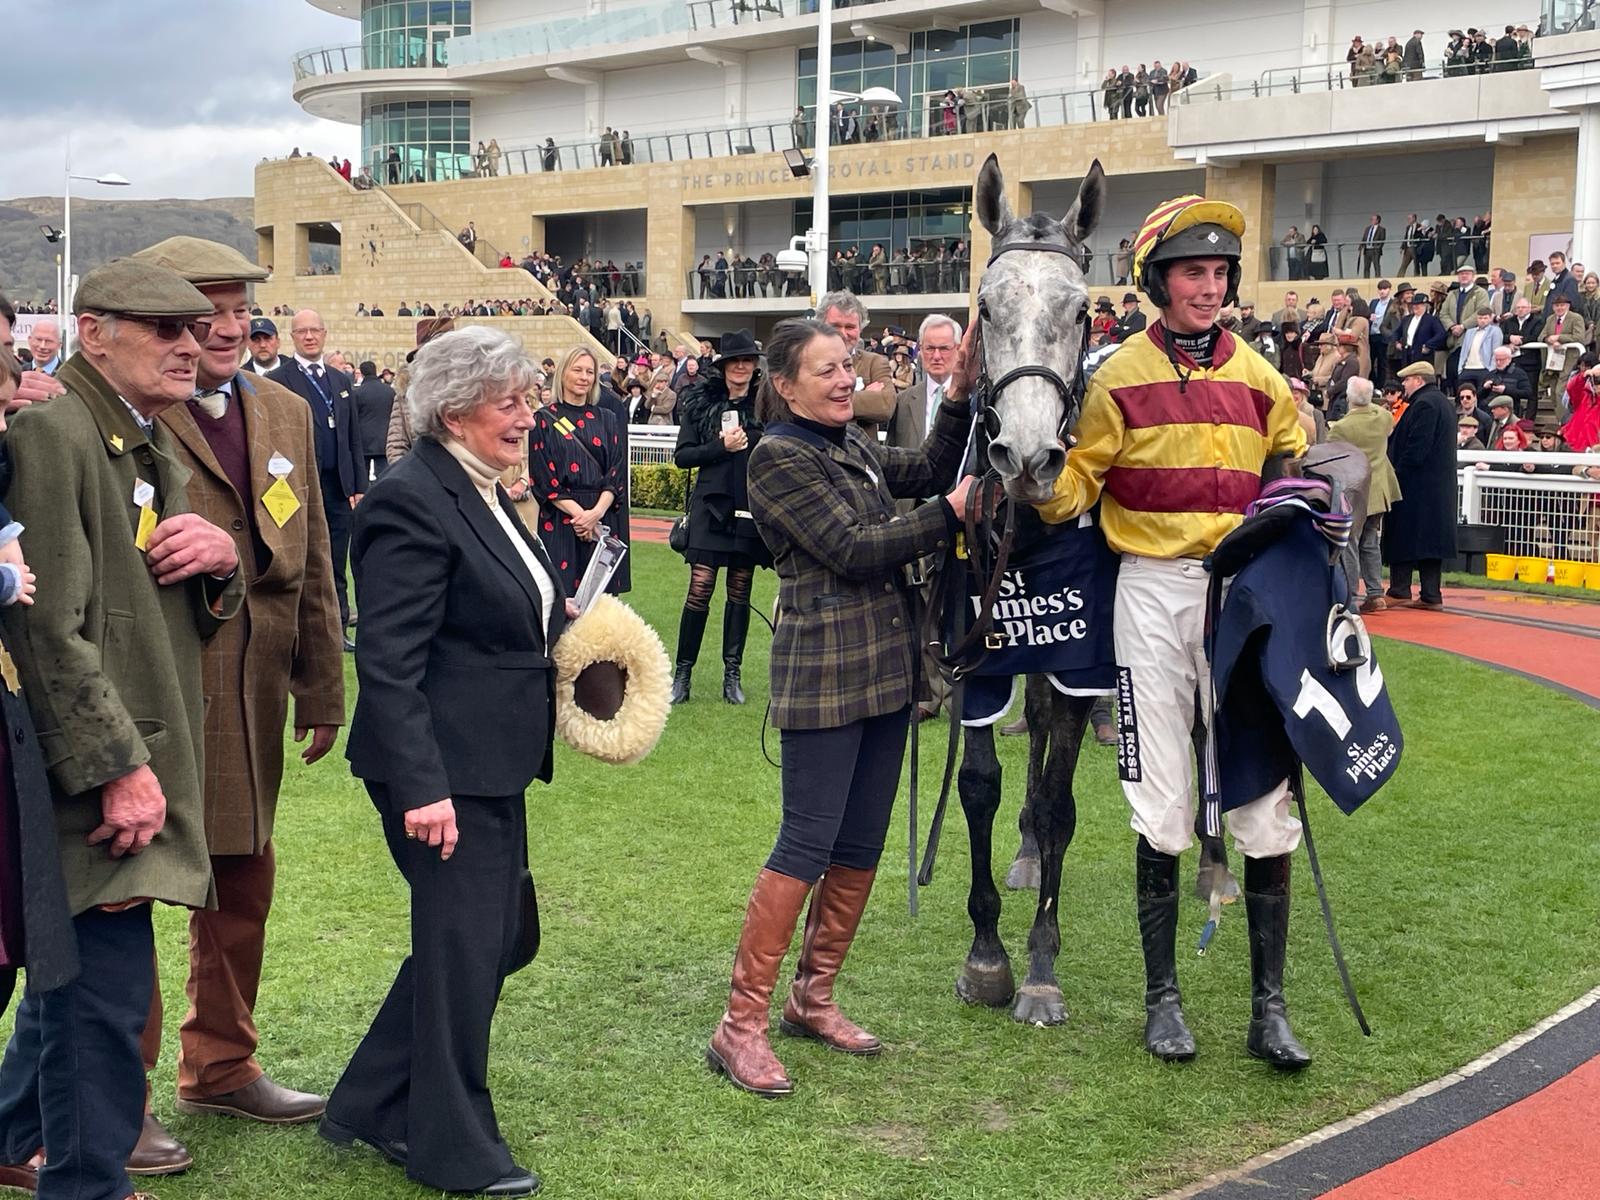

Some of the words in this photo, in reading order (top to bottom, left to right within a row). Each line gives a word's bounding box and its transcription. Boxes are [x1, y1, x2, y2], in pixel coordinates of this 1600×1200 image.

[682, 174, 713, 190] THE
[724, 167, 815, 187] PRINCE
[829, 159, 892, 178] ROYAL
[905, 153, 975, 173] STAND
[343, 350, 379, 369] OME
[1002, 618, 1087, 647] Place
[1120, 669, 1134, 726] WHITE
[1125, 731, 1138, 779] ROSE
[1346, 731, 1389, 784] James's
[1363, 743, 1397, 781] Place
